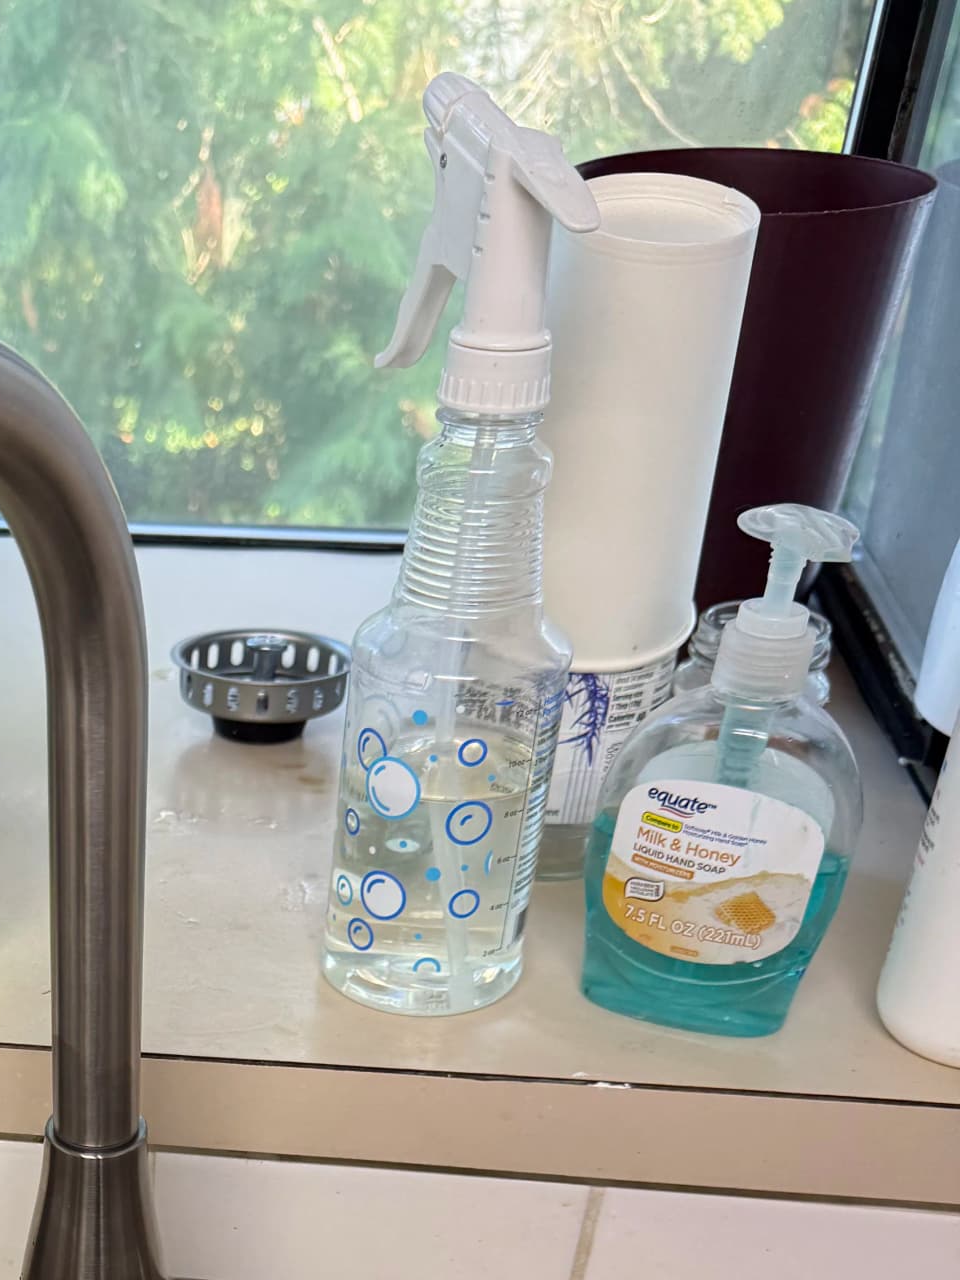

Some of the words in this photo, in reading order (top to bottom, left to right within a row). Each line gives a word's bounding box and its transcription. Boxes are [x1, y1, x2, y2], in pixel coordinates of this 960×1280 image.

[648, 787, 709, 814] equate
[633, 843, 665, 859] LIQUID
[665, 854, 696, 868] HAND
[696, 862, 726, 874] SOAP
[636, 826, 666, 847] Milk
[669, 838, 681, 851] &
[685, 842, 742, 867] Honey
[624, 904, 646, 922] 7.5
[648, 913, 667, 931] FL
[671, 920, 696, 937] OZ
[697, 925, 761, 950] (221mL)
